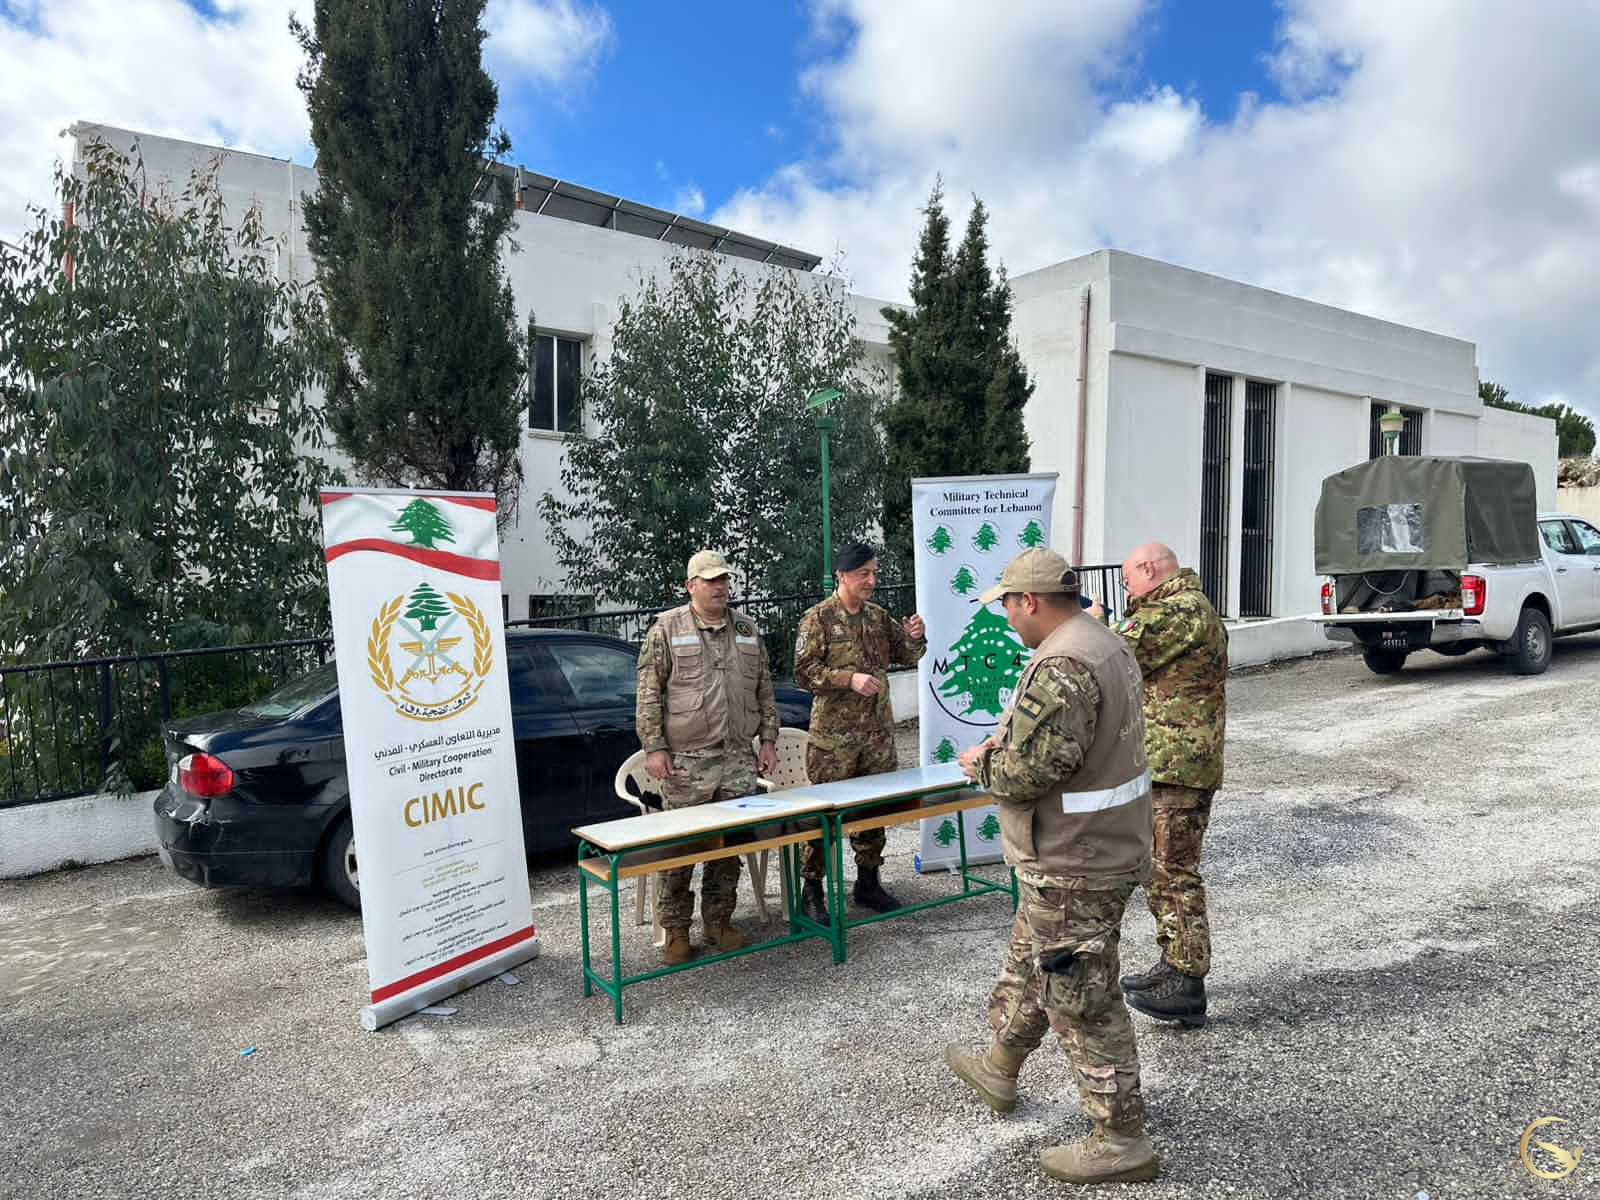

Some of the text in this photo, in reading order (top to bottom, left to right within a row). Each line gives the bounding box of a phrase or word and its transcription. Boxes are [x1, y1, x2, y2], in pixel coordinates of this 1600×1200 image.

[943, 488, 1028, 503] Military Technical
[930, 503, 1043, 517] Committee for Lebanon
[445, 730, 475, 745] التعاون
[477, 727, 501, 738] مديرية
[374, 744, 403, 760] المدني
[409, 736, 443, 752] العسكري
[389, 763, 406, 776] Civil
[412, 757, 441, 771] Military
[443, 747, 492, 764] Cooperation
[419, 765, 463, 782] Directorate
[403, 782, 486, 828] CIMIC
